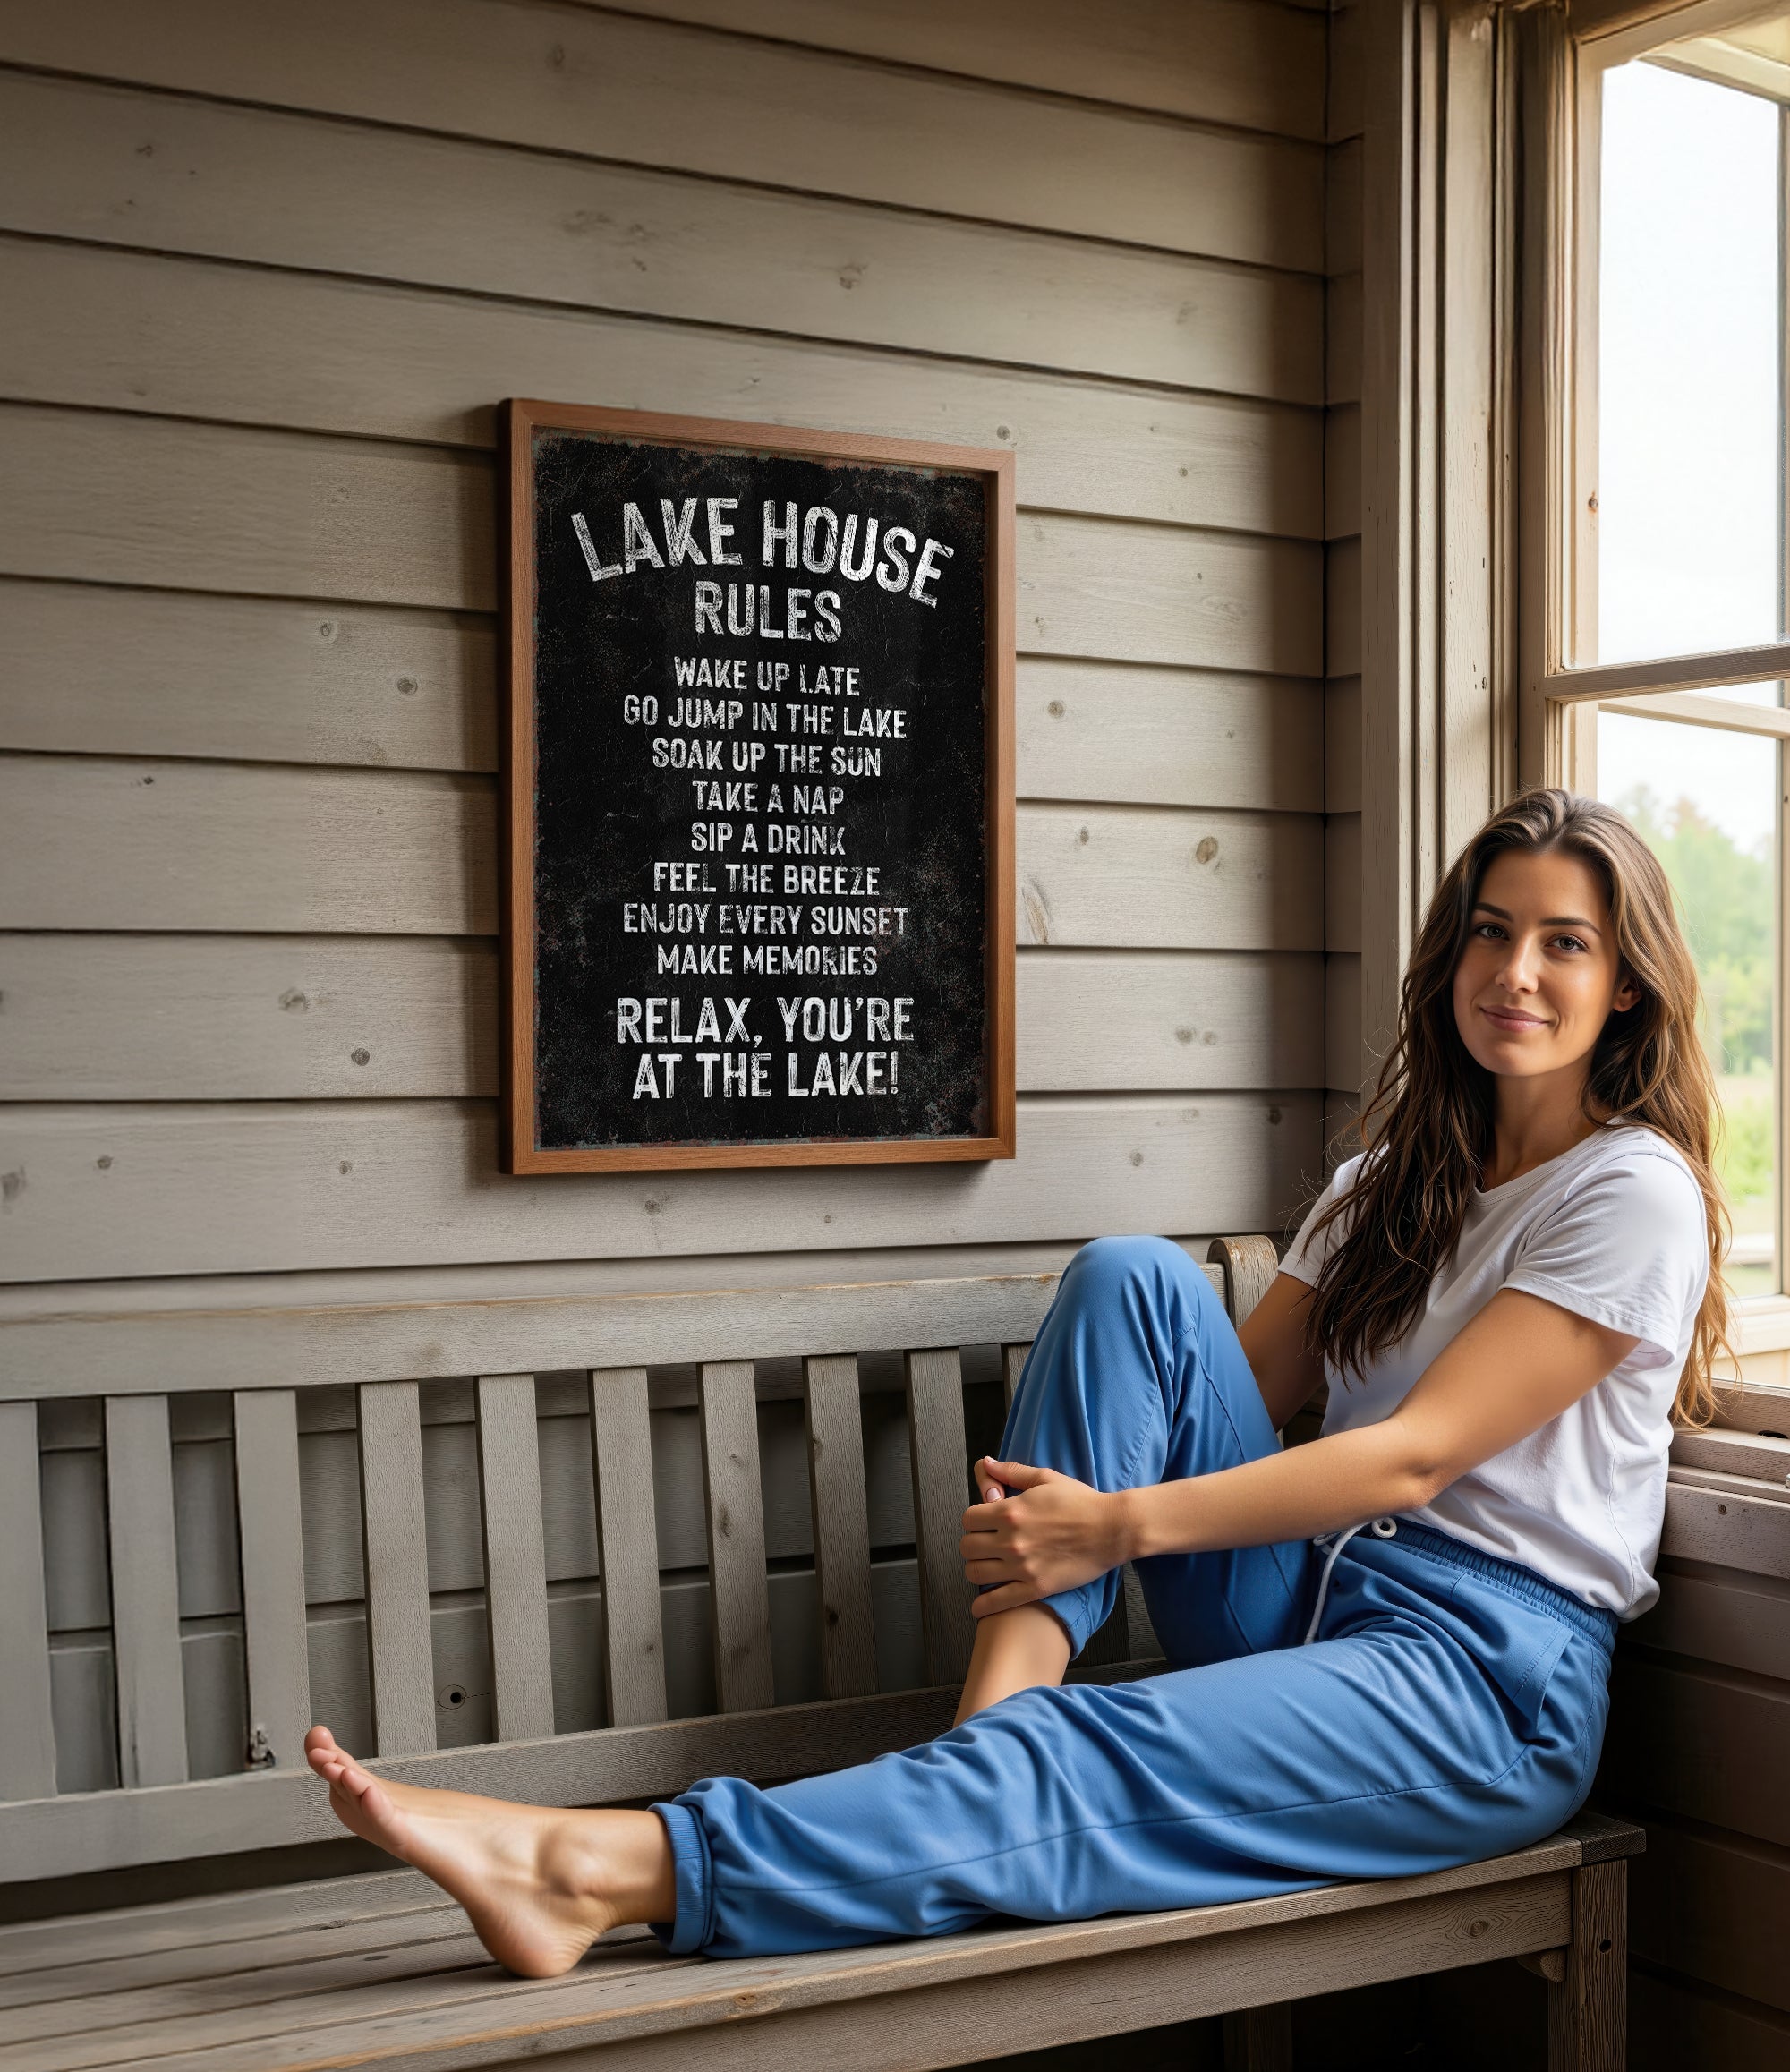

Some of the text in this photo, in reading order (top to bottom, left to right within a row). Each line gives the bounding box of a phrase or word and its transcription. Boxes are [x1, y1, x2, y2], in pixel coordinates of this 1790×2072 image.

[570, 498, 954, 608] LAKE HOUSE
[695, 580, 842, 643] RULES
[674, 657, 860, 696] WAKE UP LATE
[624, 695, 908, 739] GO JUMP IN THE LAKE
[652, 738, 881, 776] SOAK UP THE SUN
[692, 780, 844, 815] TAKE A NAP
[691, 823, 846, 855] SIP A DRINK
[653, 862, 881, 896] FEEL THE BREEZE
[624, 903, 908, 936] ENJOY EVERY SUNSET
[657, 944, 878, 976] MAKE MEMORIES
[617, 996, 915, 1048] RELAX, YOU'RE
[632, 1051, 899, 1099] AT THE LAKE!
